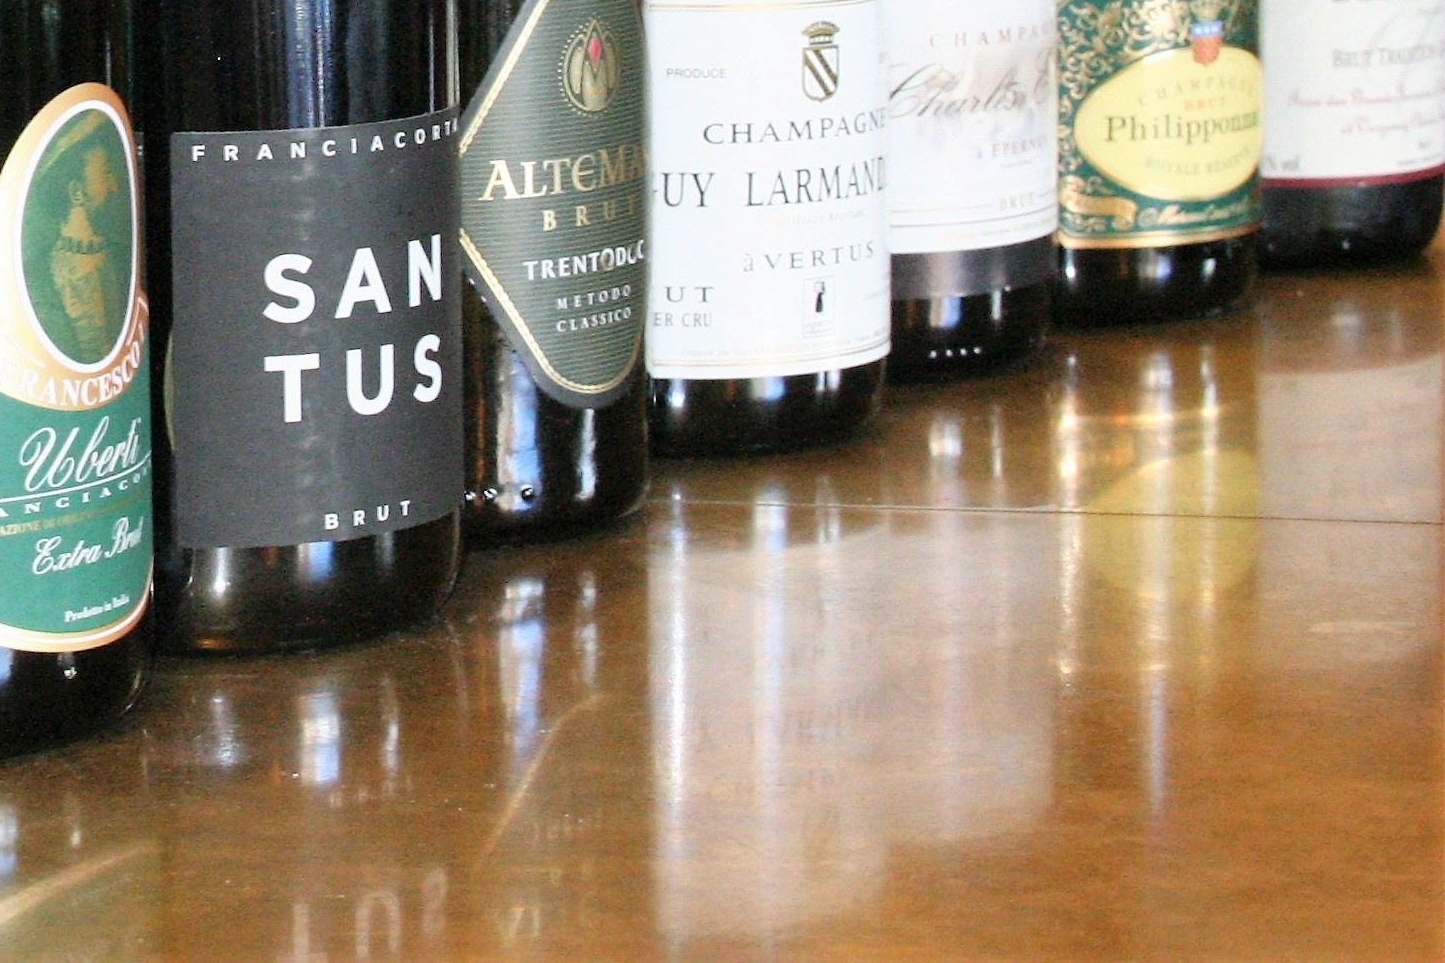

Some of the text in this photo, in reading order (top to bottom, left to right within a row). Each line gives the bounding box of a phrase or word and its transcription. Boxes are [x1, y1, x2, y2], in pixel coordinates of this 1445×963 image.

[666, 67, 727, 79] PRODUCE
[654, 171, 716, 209] UY
[764, 240, 875, 270] VERTUS
[262, 233, 443, 325] SAN
[557, 284, 631, 310] METODO
[557, 306, 633, 333] CLASSICO
[682, 312, 713, 328] CRU
[263, 333, 444, 423] TUS
[19, 415, 143, 493] Uberti
[324, 500, 412, 531] BRUT
[32, 536, 103, 575] Extra
